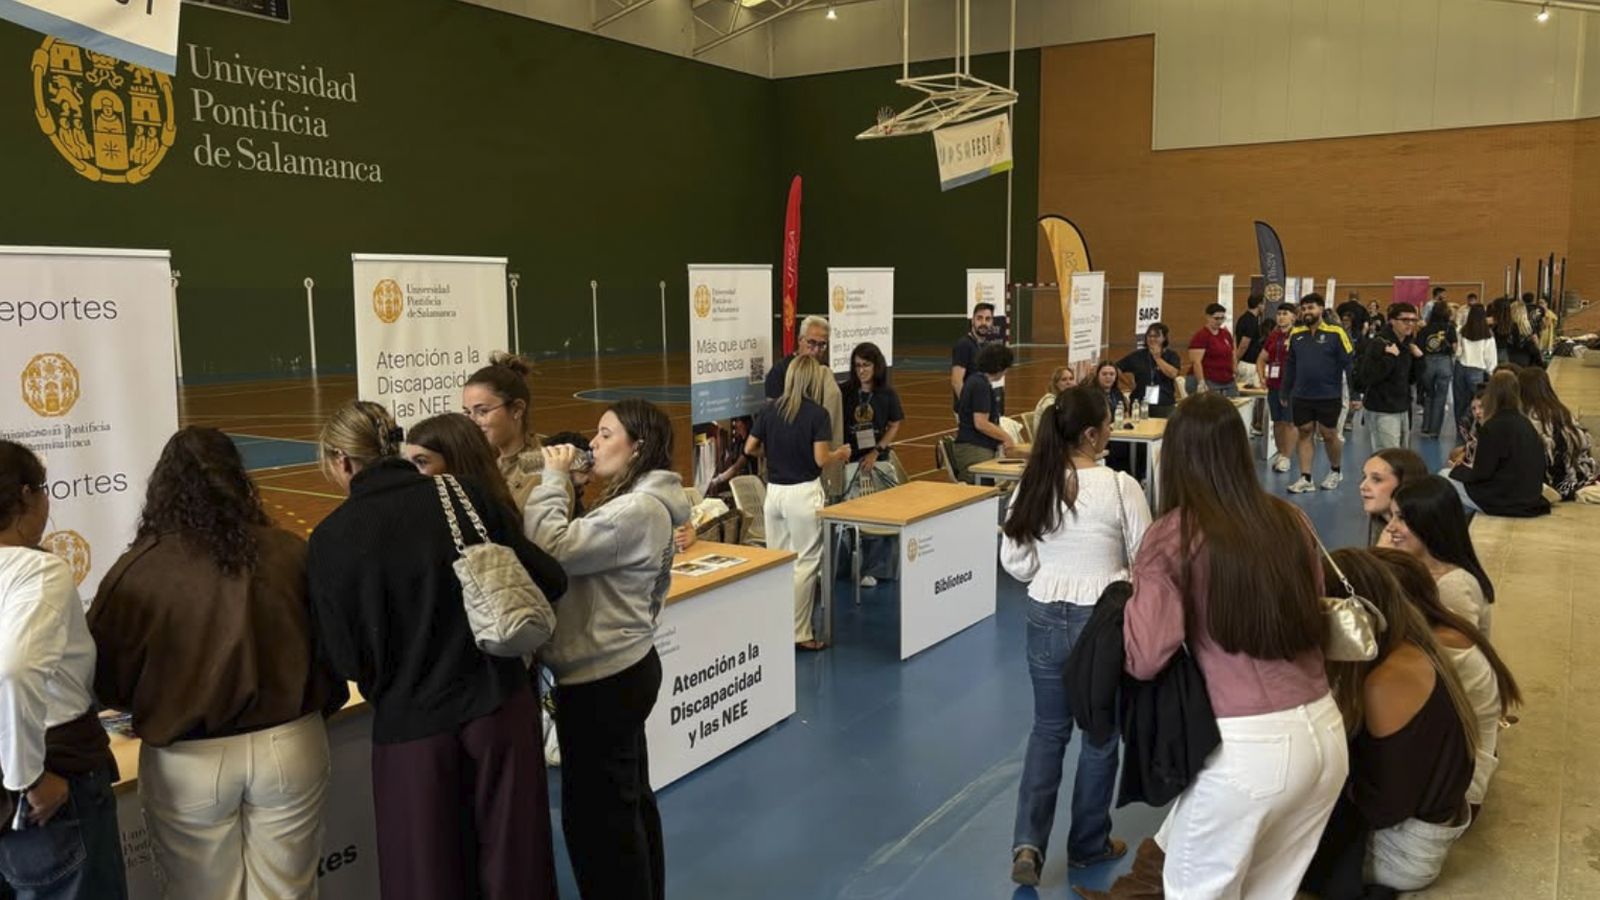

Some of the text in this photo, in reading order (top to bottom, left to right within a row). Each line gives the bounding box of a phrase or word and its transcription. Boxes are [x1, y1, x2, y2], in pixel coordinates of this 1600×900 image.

[186, 43, 358, 103] Universidad
[190, 88, 329, 138] Pontificia
[193, 133, 384, 184] de Salamanca
[0, 297, 118, 327] eportes
[1139, 307, 1159, 321] SAPS
[376, 345, 480, 370] Atención a la
[696, 337, 758, 355] Más que una
[696, 357, 745, 375] Biblioteca
[377, 370, 473, 395] Discapacid
[392, 395, 452, 420] las NEE
[45, 473, 128, 500] ortes
[935, 571, 973, 594] Biblioteca
[672, 642, 760, 696] Atención a la
[670, 664, 762, 726] Discapacidad
[688, 699, 749, 749] y las NEE
